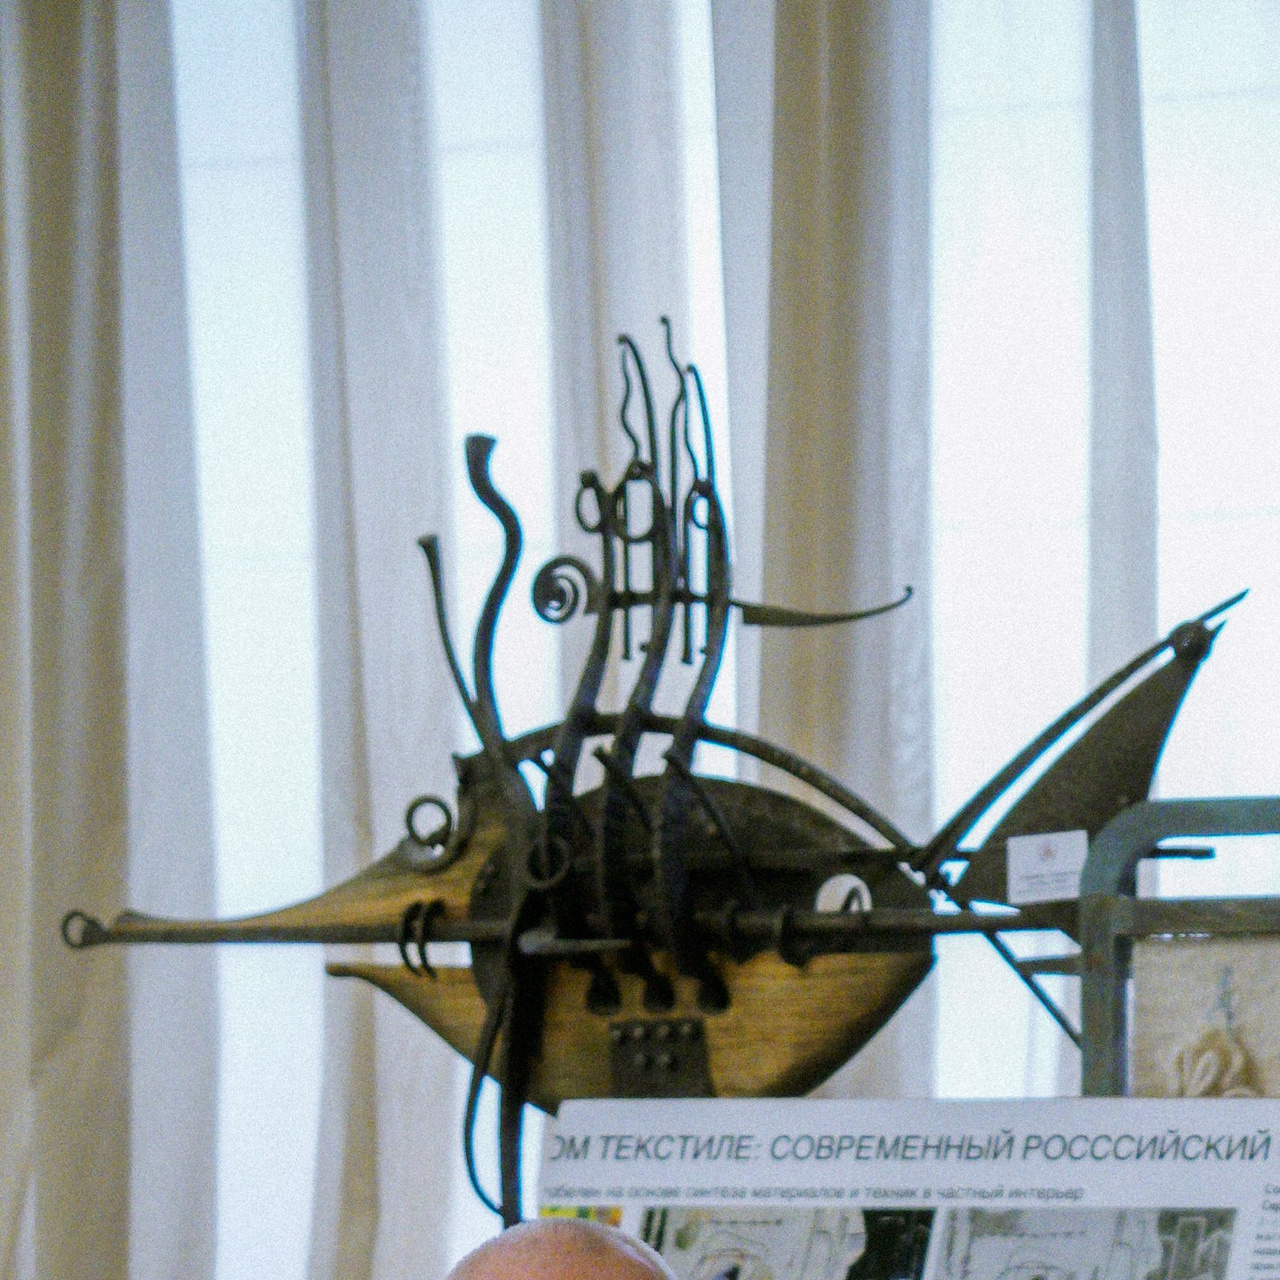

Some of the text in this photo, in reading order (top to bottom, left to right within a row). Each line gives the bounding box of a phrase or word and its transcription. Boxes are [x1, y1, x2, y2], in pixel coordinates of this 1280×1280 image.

[600, 1134, 762, 1160] ТЕКСТИЛЕ:
[770, 1128, 1015, 1160] СОВРЕМЕННЫЙ
[1022, 1128, 1272, 1161] РОСССИЙСКИЙ
